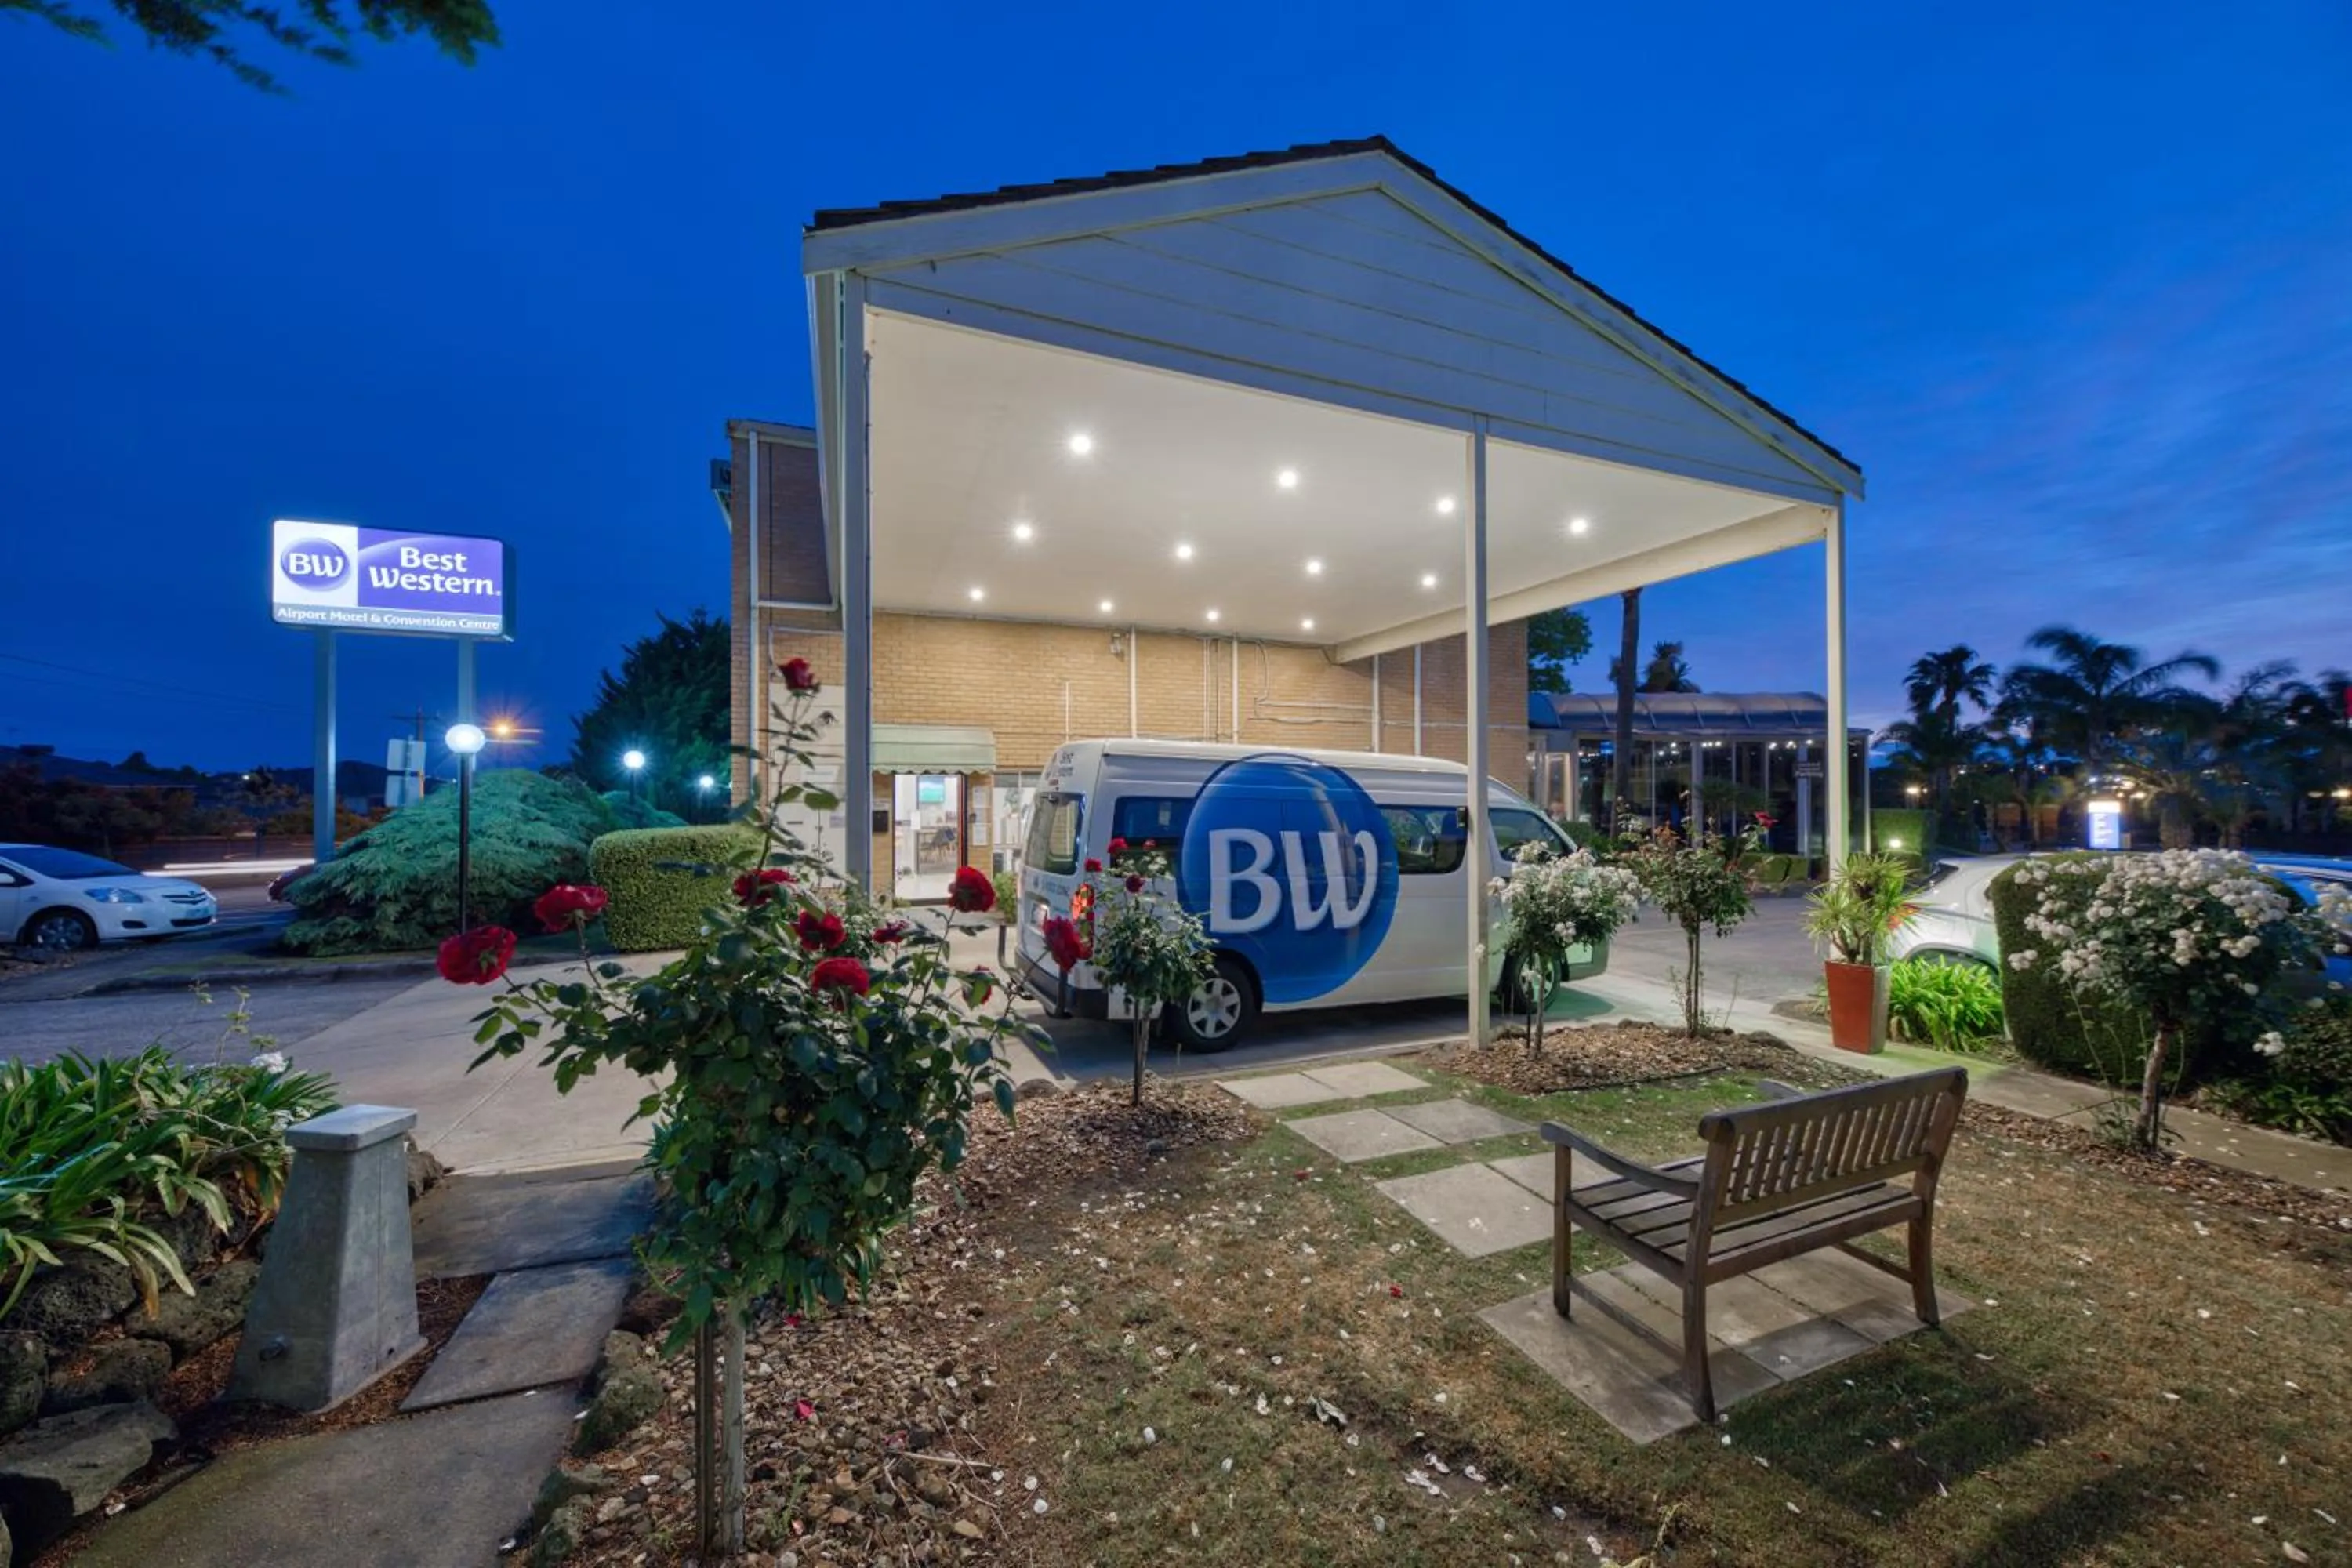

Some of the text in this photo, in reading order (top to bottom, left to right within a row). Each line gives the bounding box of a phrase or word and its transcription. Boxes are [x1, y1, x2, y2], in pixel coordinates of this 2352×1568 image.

[289, 553, 343, 578] BW
[401, 546, 467, 572] Best
[278, 607, 499, 630] Airport Motel & Convention Centre
[1209, 828, 1379, 934] BW
